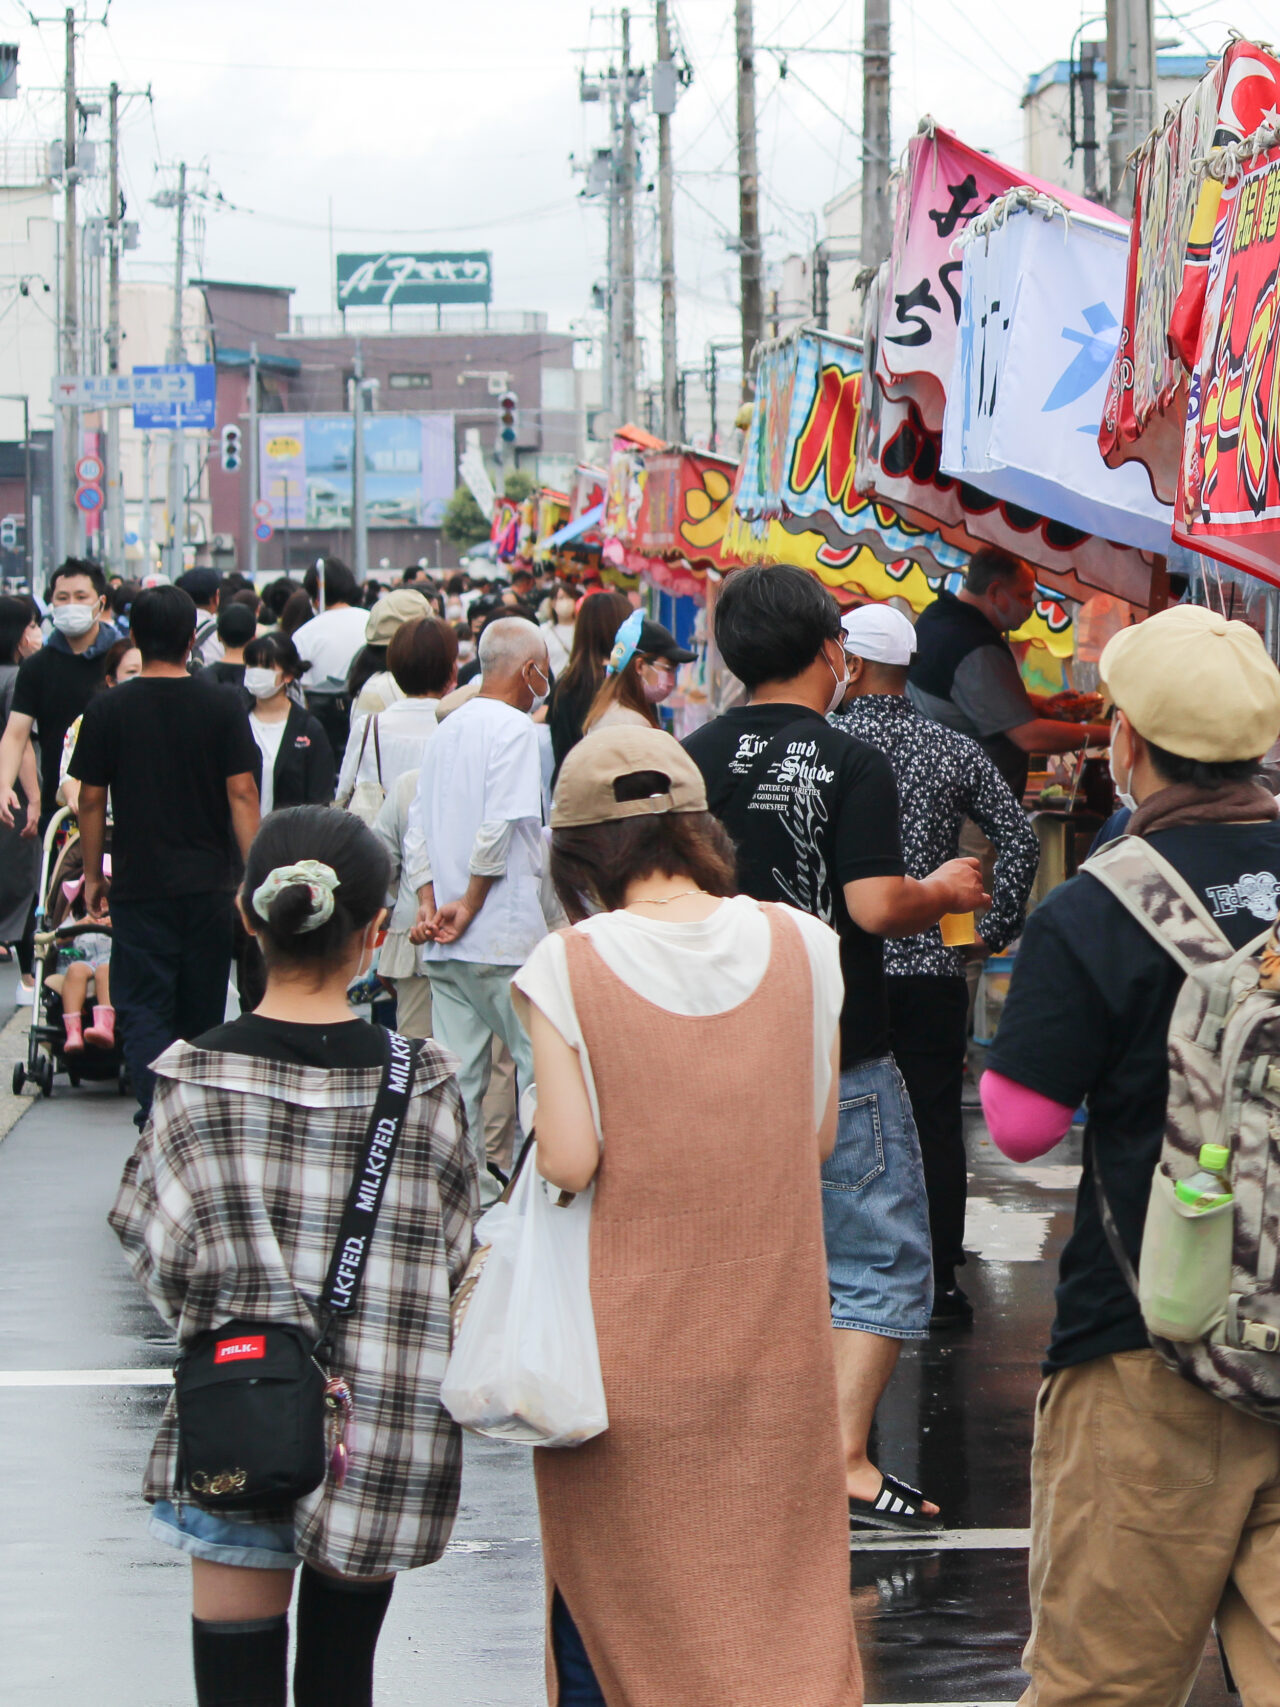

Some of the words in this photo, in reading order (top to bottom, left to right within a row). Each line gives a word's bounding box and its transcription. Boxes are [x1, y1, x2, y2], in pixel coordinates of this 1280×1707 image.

[787, 740, 816, 757] and
[777, 755, 834, 783] Shade
[355, 1117, 399, 1212] MILKFED.
[220, 1343, 258, 1356] MILK
